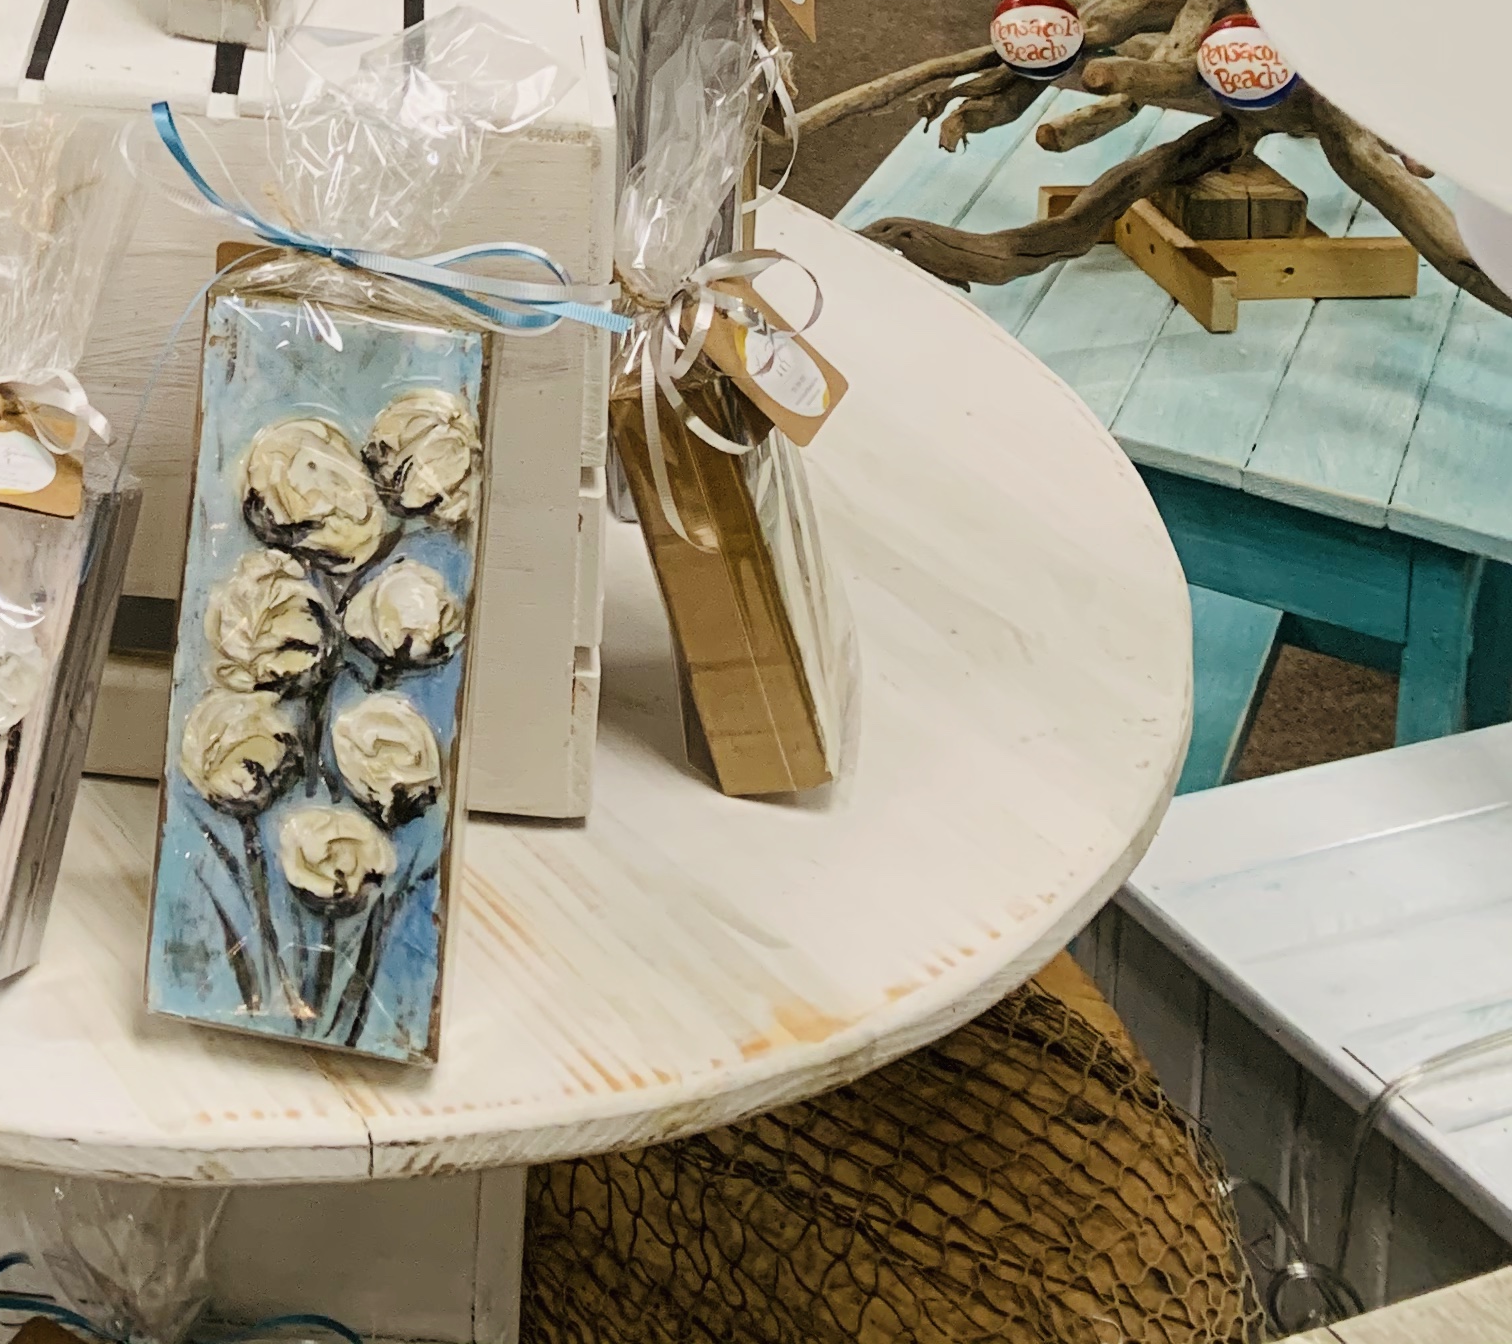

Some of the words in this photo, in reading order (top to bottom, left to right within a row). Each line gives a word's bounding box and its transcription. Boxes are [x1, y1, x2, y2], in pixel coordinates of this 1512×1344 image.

[993, 15, 1080, 40] Pensacola
[1002, 39, 1068, 62] Beach
[1201, 41, 1283, 66] Pensacol
[1215, 67, 1288, 94] Beach
